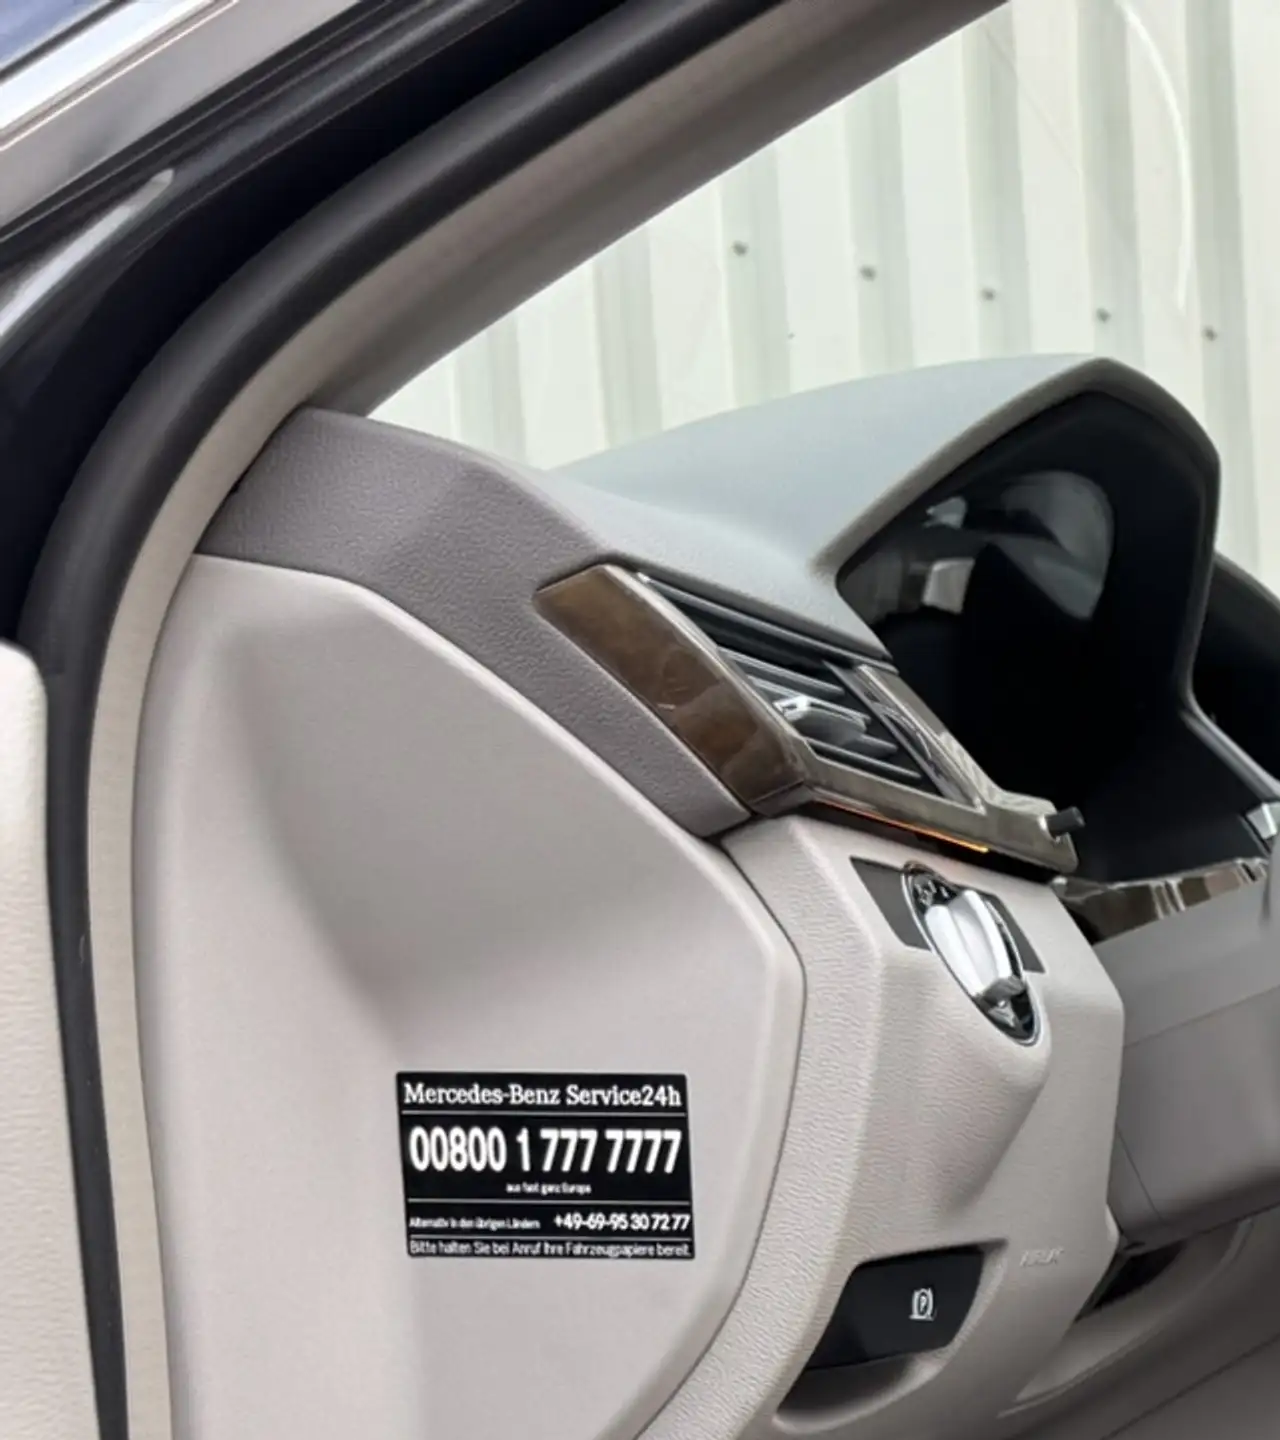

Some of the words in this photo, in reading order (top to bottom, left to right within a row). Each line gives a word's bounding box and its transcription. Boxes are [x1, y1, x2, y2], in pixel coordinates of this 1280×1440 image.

[403, 1082, 561, 1106] Mercedes-Benz
[565, 1083, 683, 1107] Service24h
[408, 1125, 507, 1172] 00800
[515, 1127, 531, 1172] 1
[539, 1128, 599, 1173] 777
[604, 1129, 683, 1174] 7777
[554, 1212, 629, 1232] +49-69-95
[629, 1212, 650, 1231] 30
[651, 1213, 671, 1231] 72
[671, 1213, 691, 1231] 77
